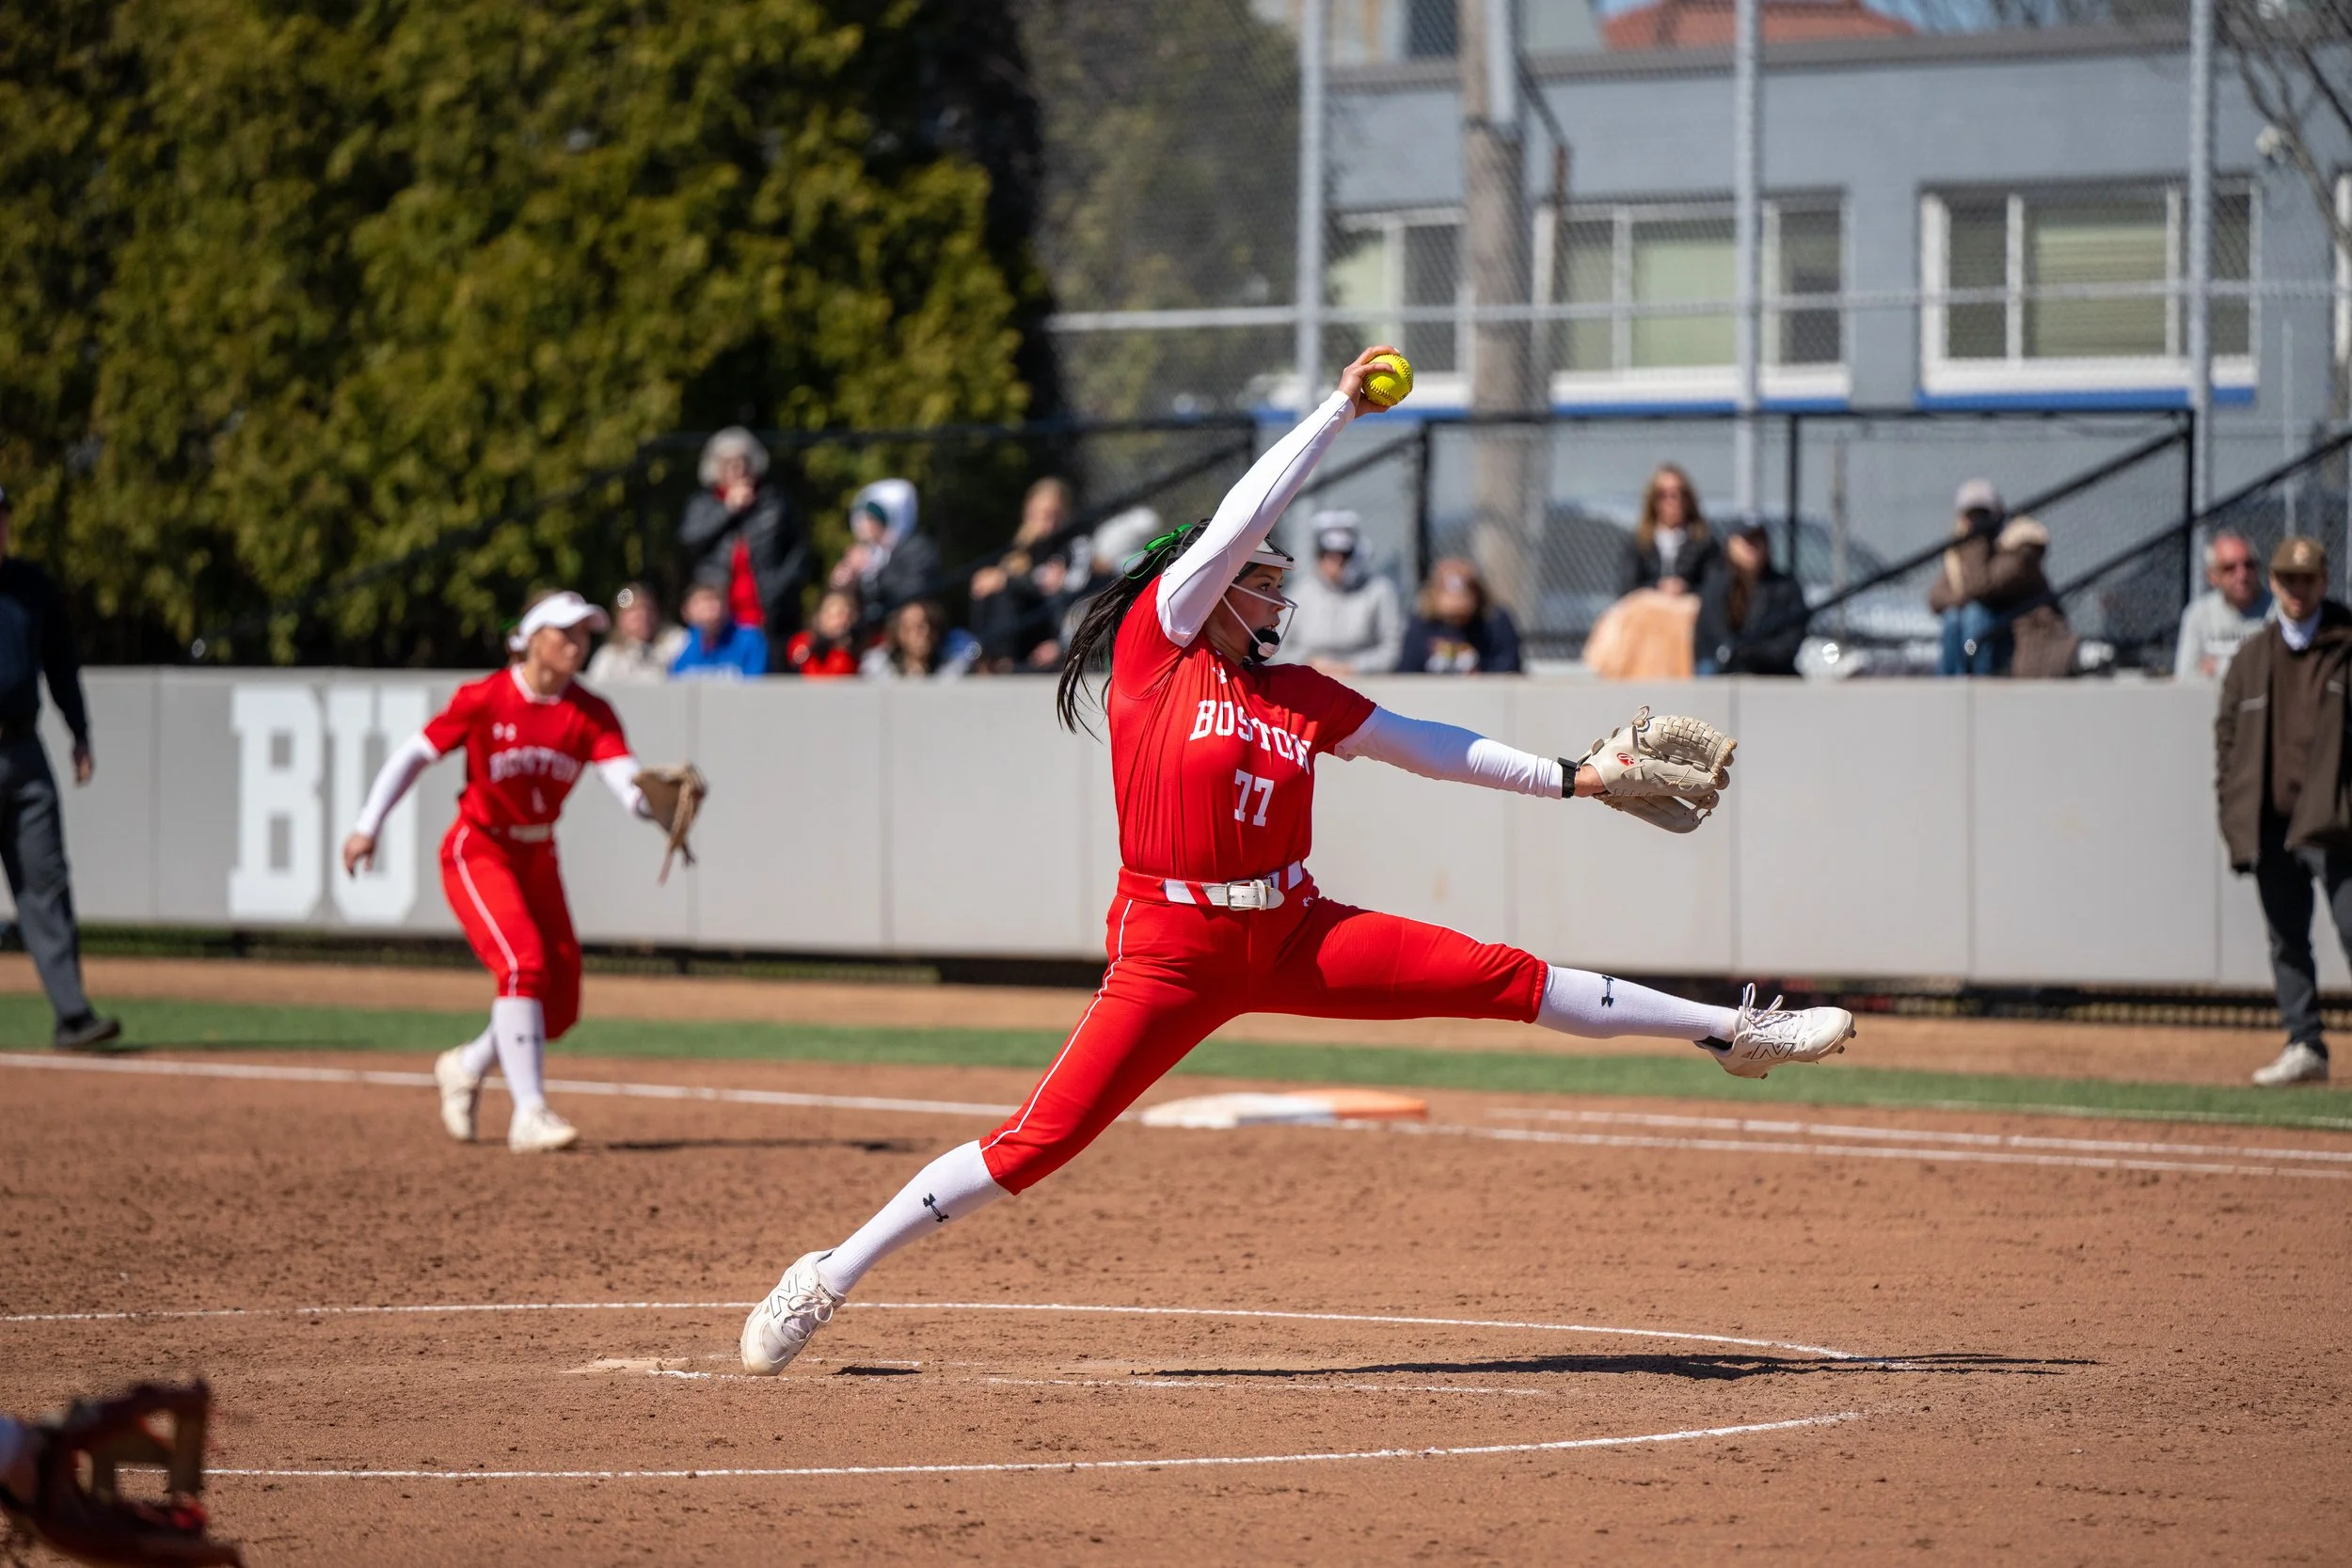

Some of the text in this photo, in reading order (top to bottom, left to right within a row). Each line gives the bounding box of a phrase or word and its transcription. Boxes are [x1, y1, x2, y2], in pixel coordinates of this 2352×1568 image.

[1188, 699, 1311, 776] BOSTON
[230, 687, 428, 920] BU
[1233, 768, 1274, 827] 77
